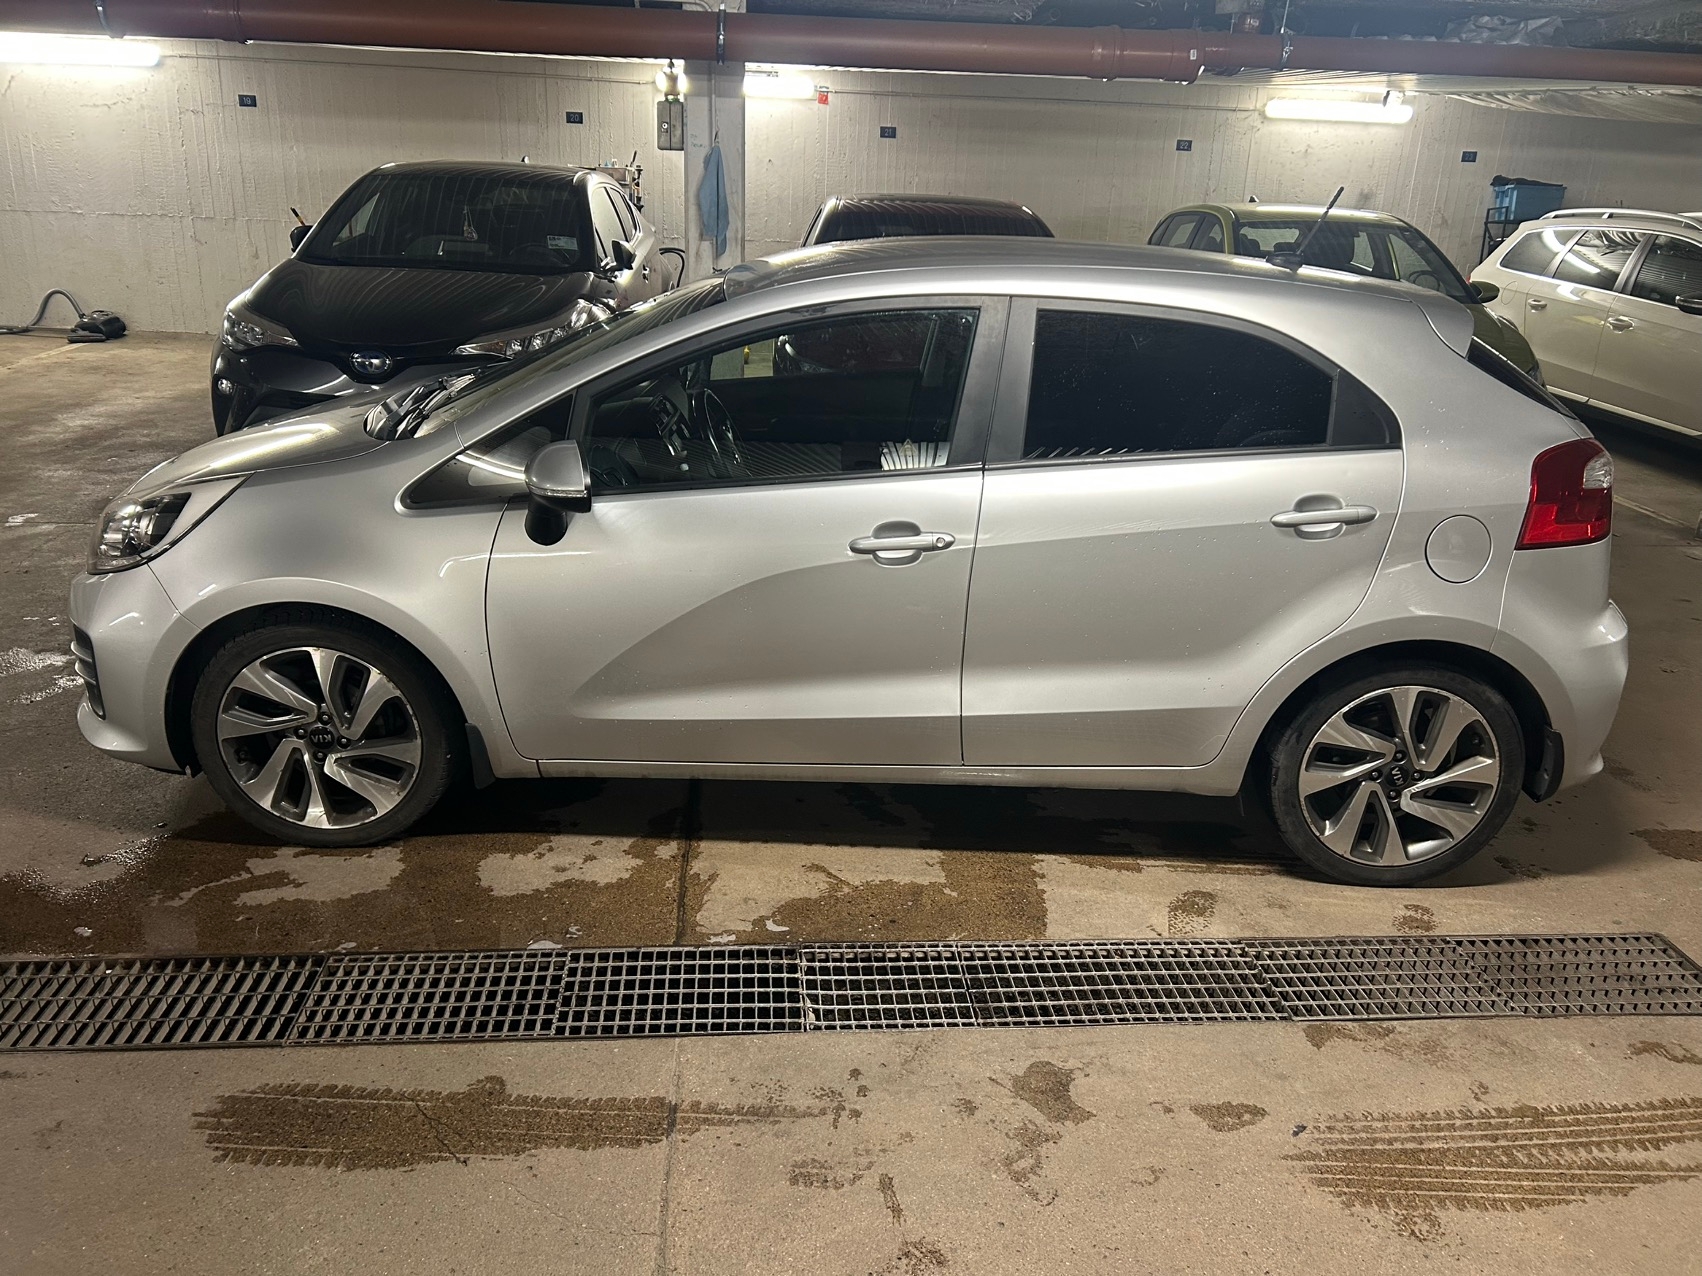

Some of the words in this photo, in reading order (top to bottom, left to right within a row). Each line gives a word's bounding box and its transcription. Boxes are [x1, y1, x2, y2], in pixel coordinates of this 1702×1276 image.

[243, 97, 251, 105] 19
[570, 114, 579, 122] 20
[885, 128, 892, 136] 21
[1180, 141, 1189, 149] 22
[311, 734, 332, 743] KIA
[1391, 767, 1404, 786] KIA
